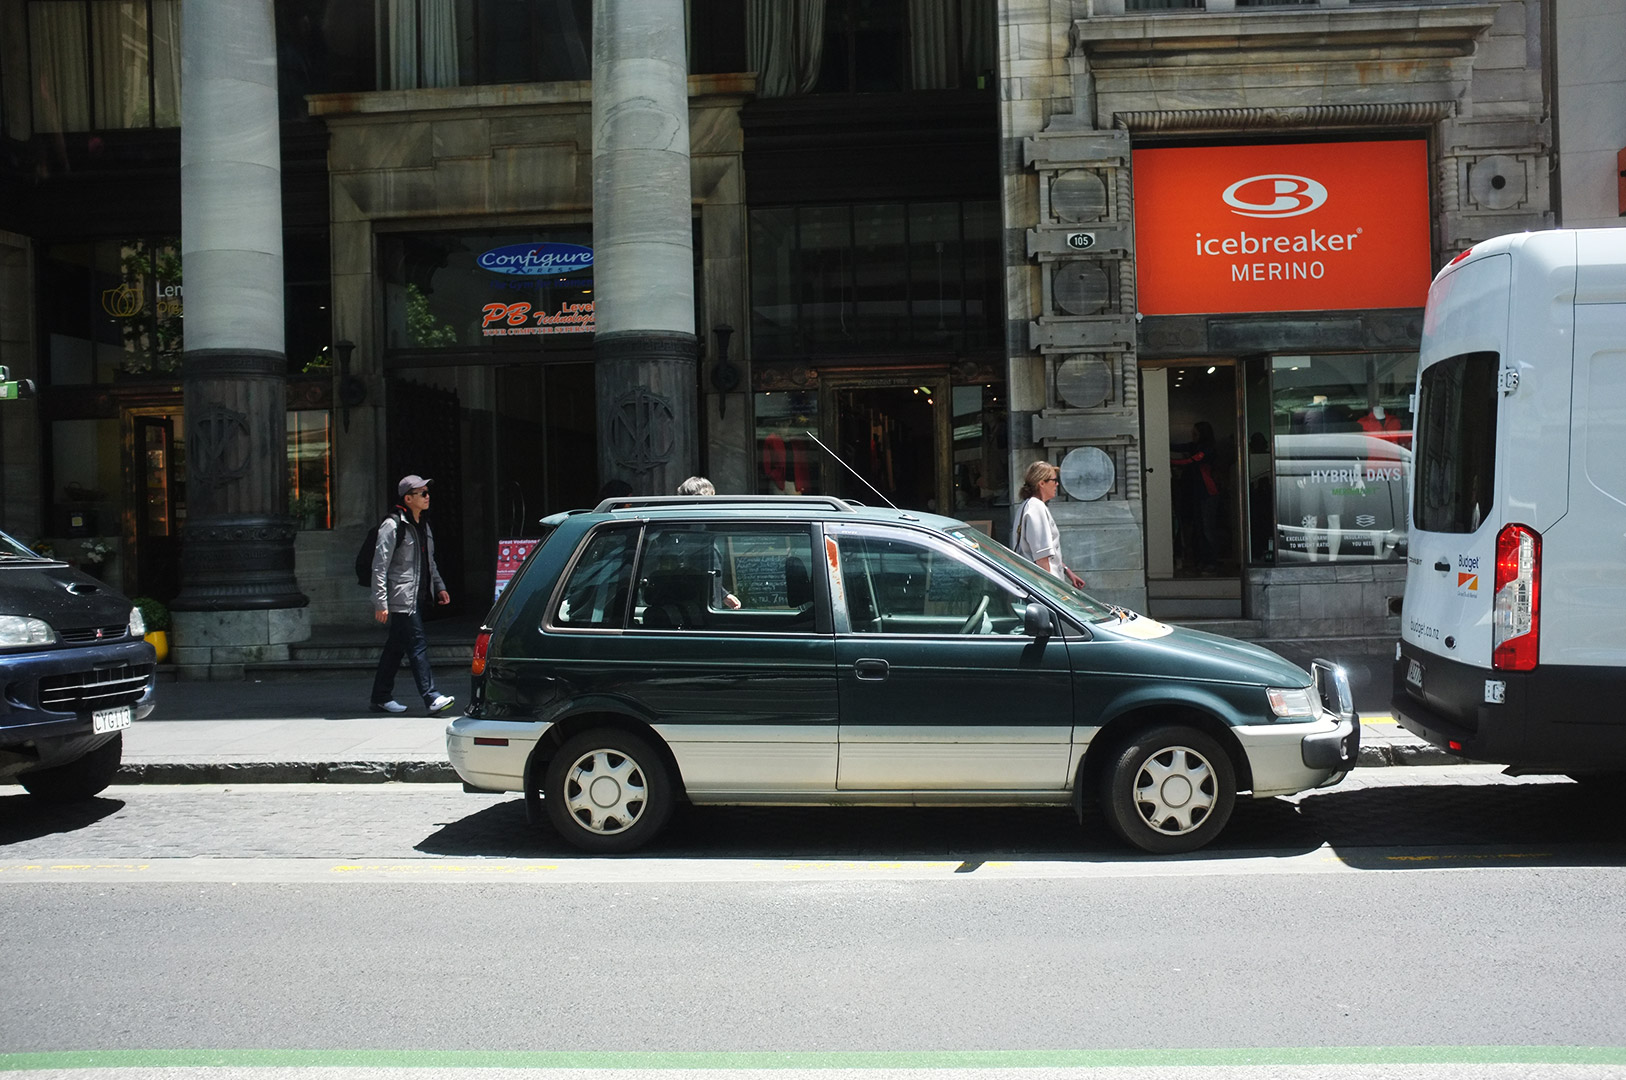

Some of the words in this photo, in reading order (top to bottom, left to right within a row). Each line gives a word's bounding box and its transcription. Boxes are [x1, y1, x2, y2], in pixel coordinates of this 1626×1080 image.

[1074, 236, 1089, 246] 105
[482, 249, 594, 267] Configure
[1231, 260, 1325, 282] MERINO
[482, 302, 531, 328] PB
[1366, 468, 1402, 482] DAYS
[1459, 554, 1479, 572] Budget
[1410, 616, 1439, 640] budget.co.nz
